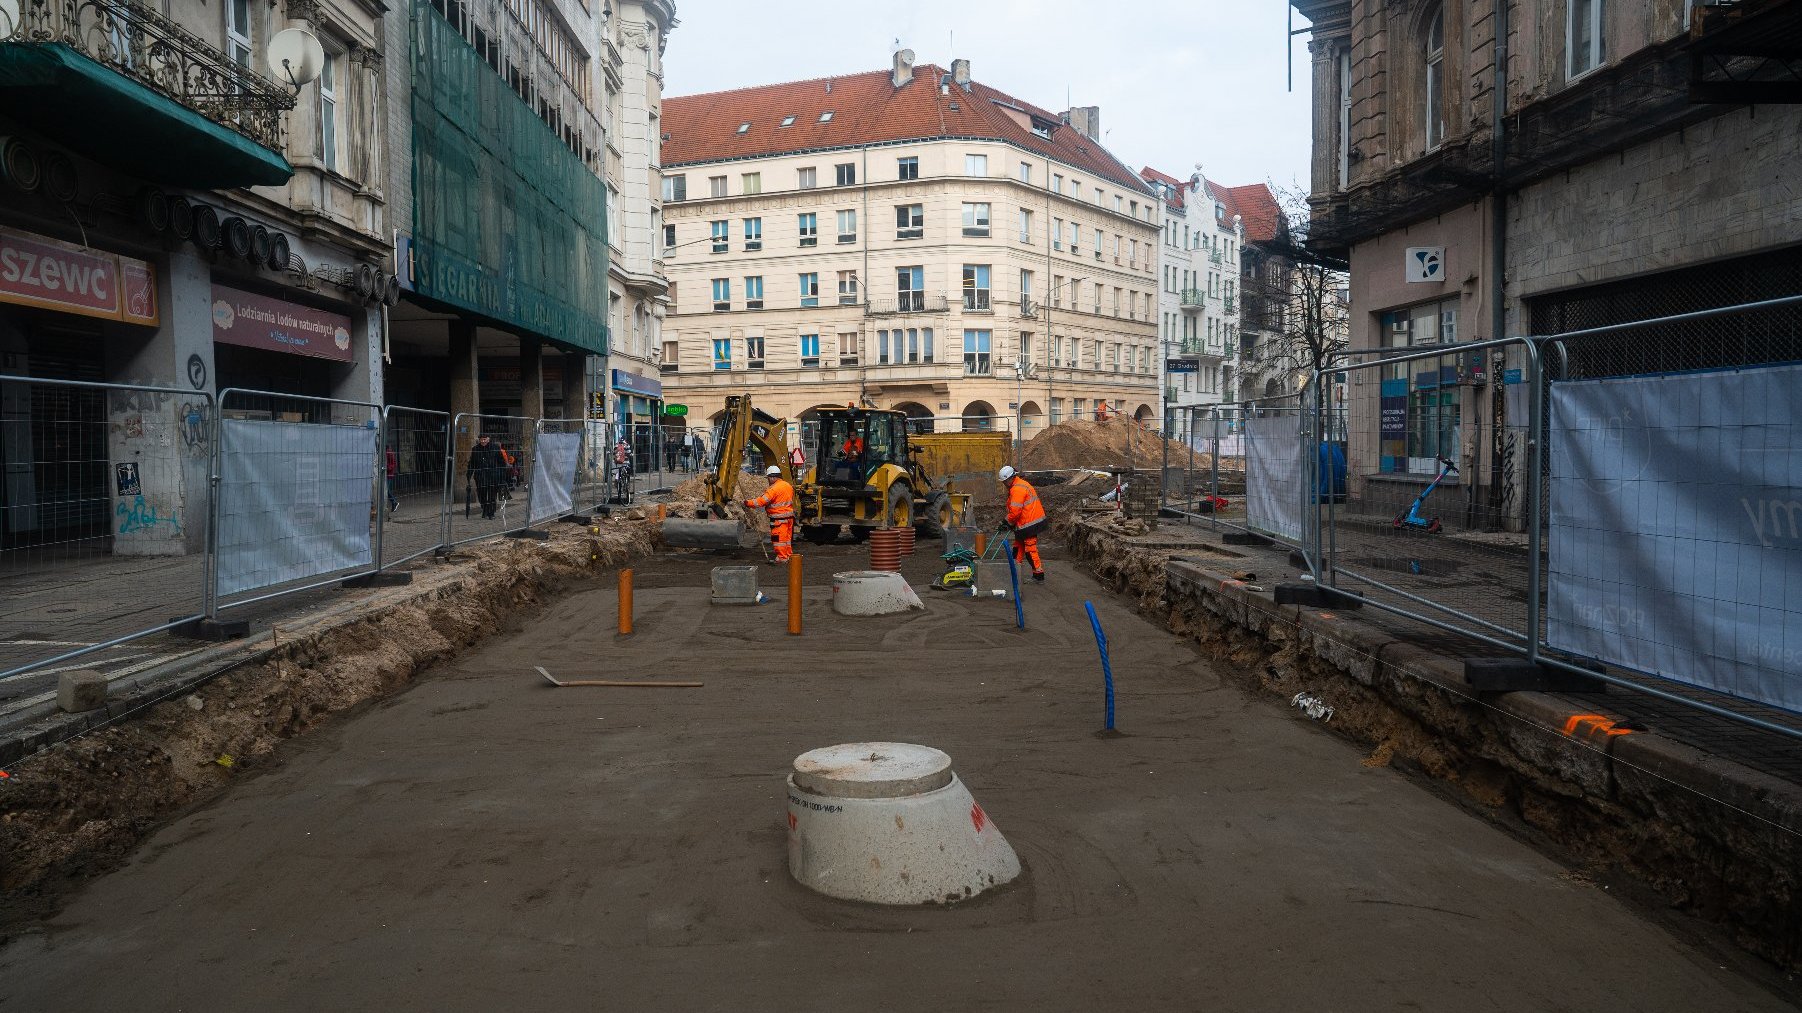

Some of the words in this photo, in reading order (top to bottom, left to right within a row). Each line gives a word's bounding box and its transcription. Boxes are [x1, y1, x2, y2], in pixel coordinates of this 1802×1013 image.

[1, 247, 107, 300] szewc
[237, 303, 276, 324] Lodziarnia
[299, 319, 334, 337] naturalnych
